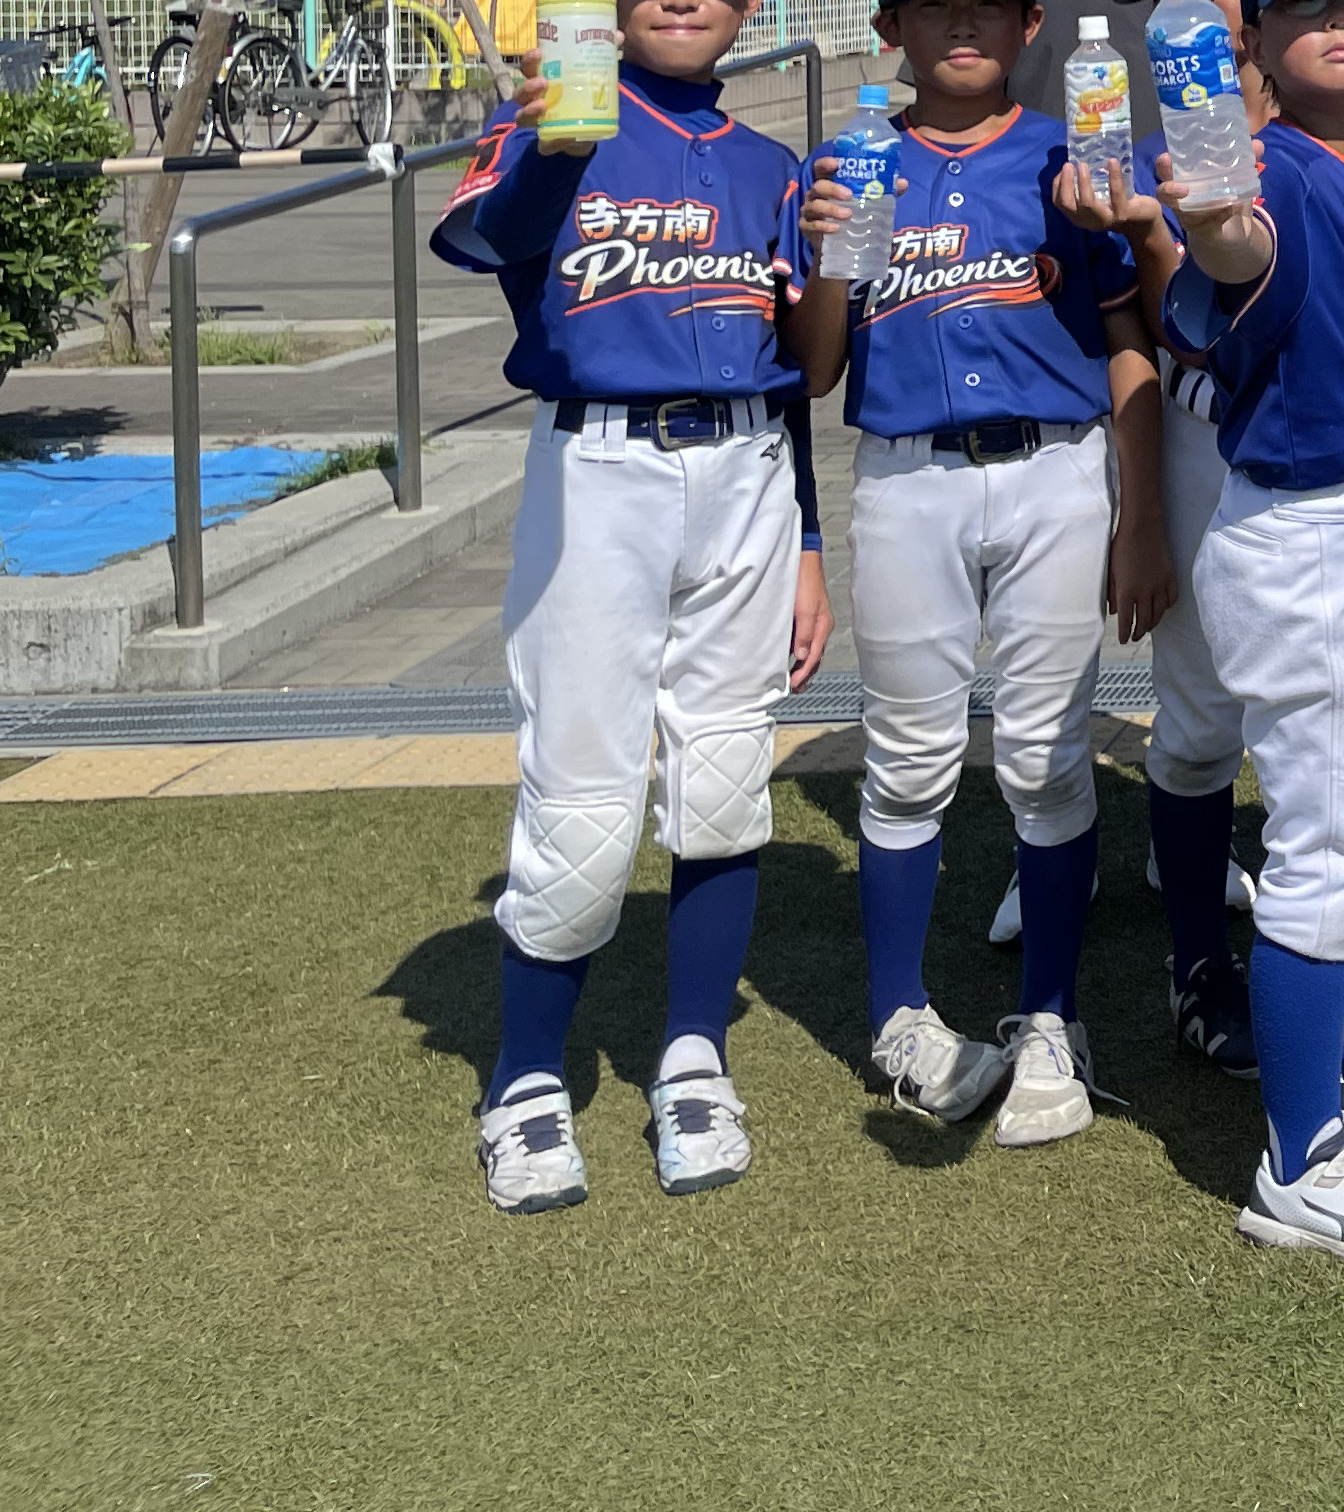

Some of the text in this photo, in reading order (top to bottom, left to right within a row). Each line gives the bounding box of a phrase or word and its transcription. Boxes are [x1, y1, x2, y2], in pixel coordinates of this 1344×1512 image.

[1152, 54, 1201, 76] ORTS
[579, 197, 712, 244] 寺方南
[892, 227, 963, 262] 方南
[561, 239, 775, 302] Phoenix
